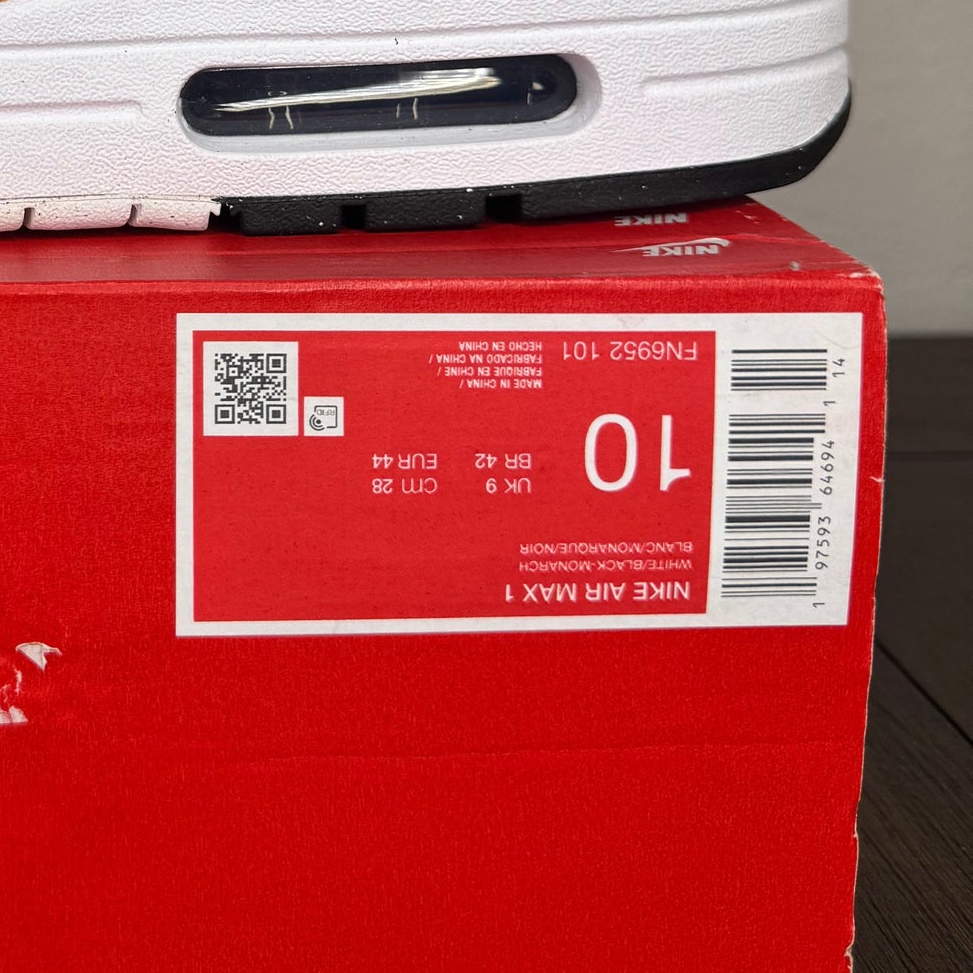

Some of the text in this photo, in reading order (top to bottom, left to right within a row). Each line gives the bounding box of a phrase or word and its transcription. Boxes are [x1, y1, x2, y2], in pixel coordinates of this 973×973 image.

[614, 213, 688, 227] NIKE
[642, 244, 719, 257] NIKE
[458, 341, 543, 352] HECHO EN CHINA
[563, 340, 699, 361] FN6952 101
[436, 354, 467, 364] CHINA
[469, 354, 484, 364] NA
[486, 354, 543, 364] FABRICADO
[444, 366, 475, 377] CHINE
[477, 366, 491, 377] EN
[494, 366, 543, 377] FABRIQUE
[831, 357, 846, 379] 14
[467, 378, 497, 389] CHINA
[500, 378, 511, 389] IN
[513, 378, 543, 389] MADE
[316, 408, 336, 417] RFID
[583, 412, 692, 493] 10
[371, 453, 438, 470] EUR 44
[474, 453, 532, 469] BR 42
[818, 439, 836, 496] 64694
[371, 478, 394, 495] 28
[485, 477, 532, 494] UK 9
[519, 541, 694, 556] BLANC/MONARQUE/NOIR
[814, 515, 832, 571] 97593
[518, 559, 693, 573] WHITE/BLACK-MONARCH
[504, 581, 691, 603] NIKE AIR MAX 1
